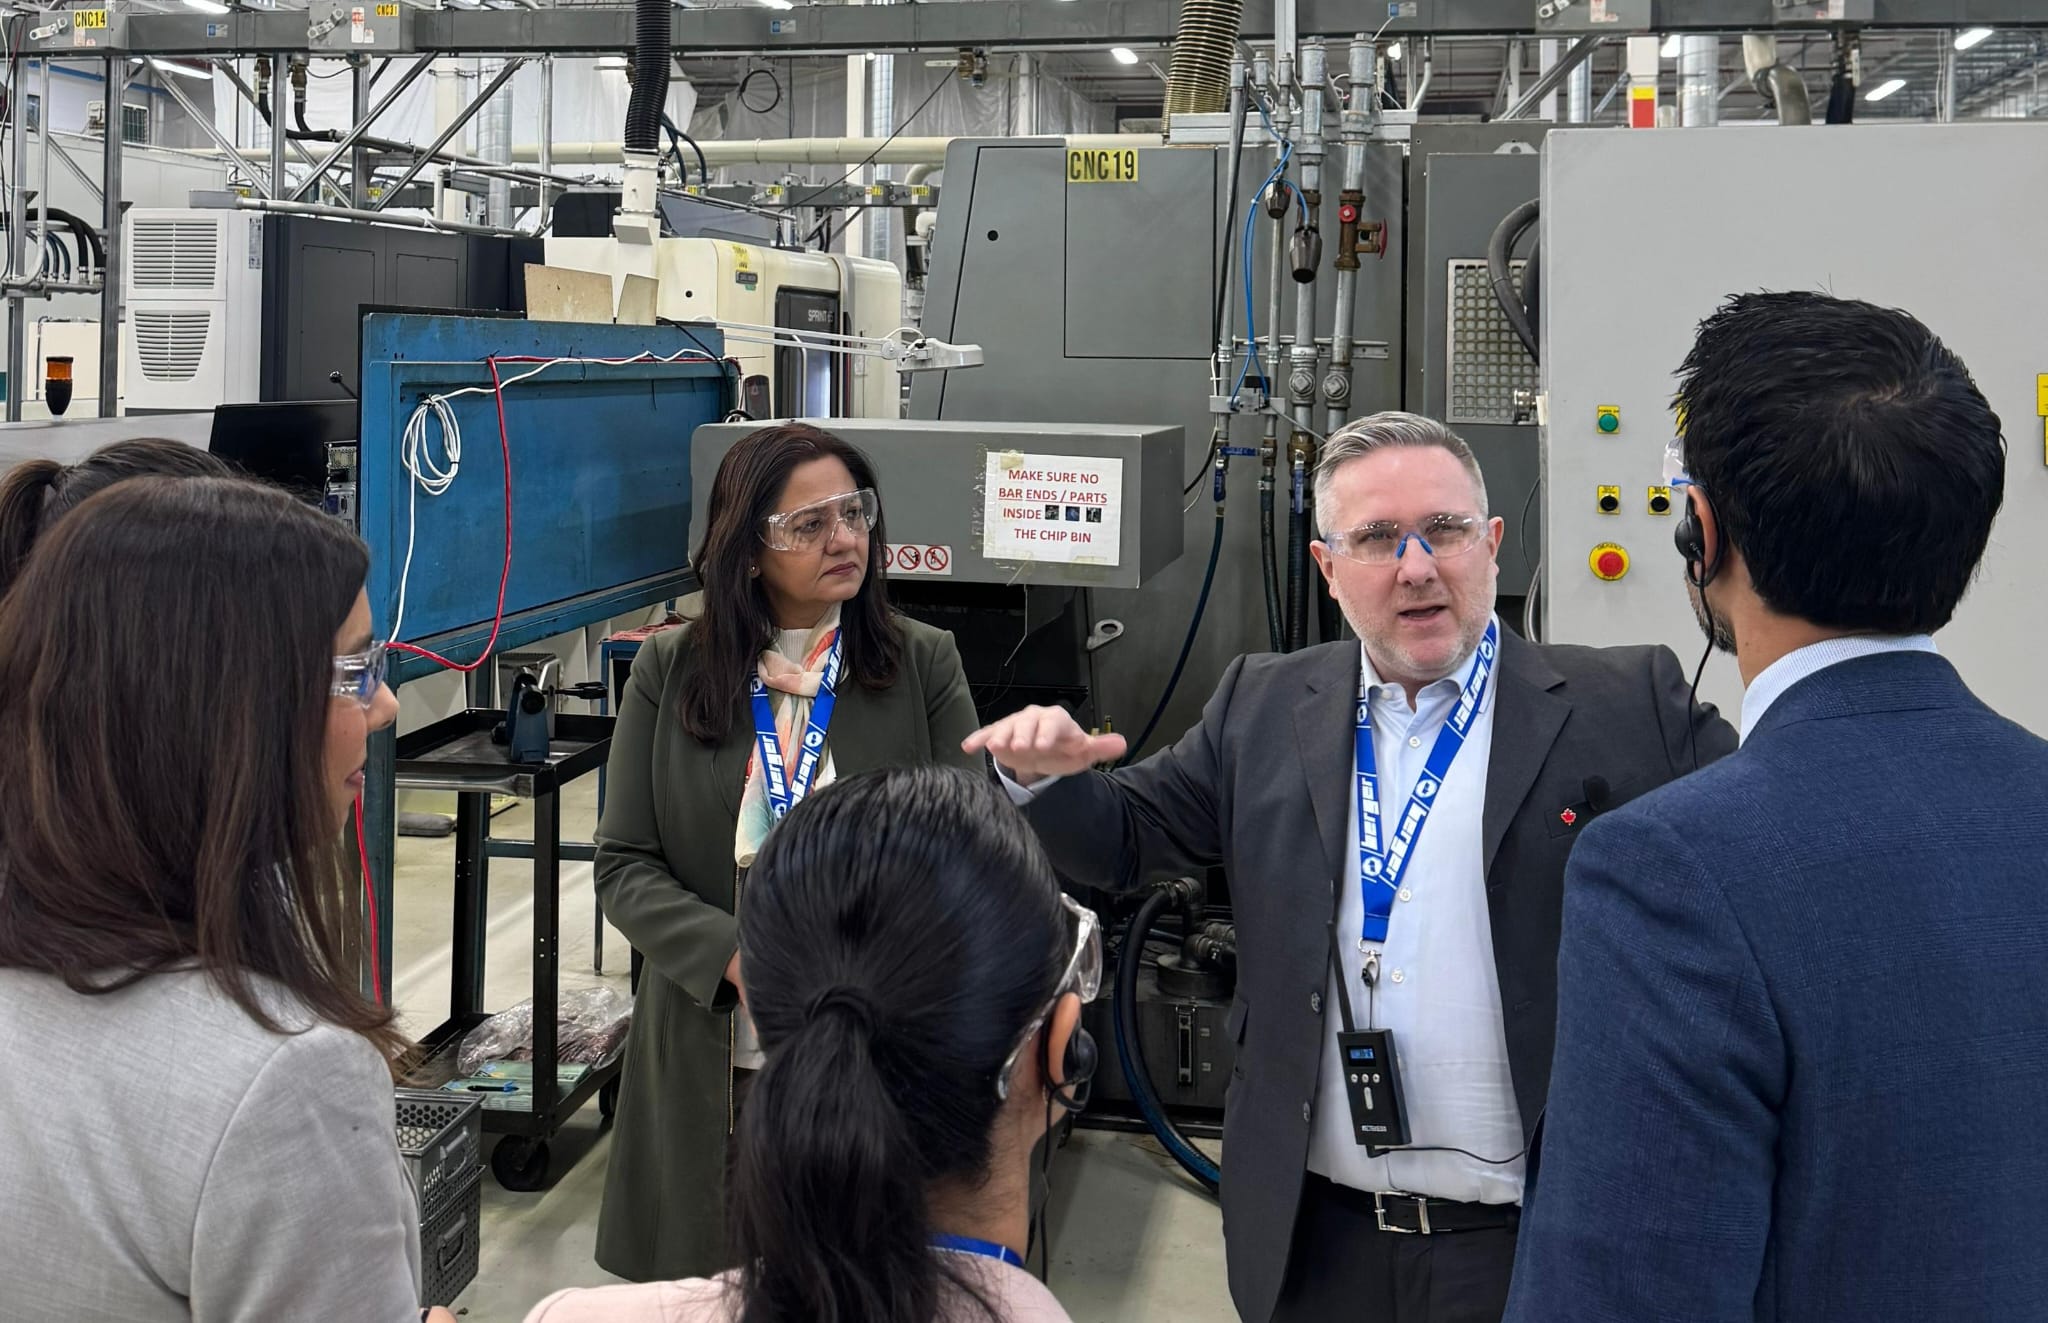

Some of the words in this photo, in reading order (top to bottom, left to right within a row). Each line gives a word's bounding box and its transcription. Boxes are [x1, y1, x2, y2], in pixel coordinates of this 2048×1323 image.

[75, 11, 106, 27] CNC14
[1070, 151, 1134, 180] CNC19
[808, 309, 827, 322] SPRINT
[1008, 469, 1043, 481] MAKE
[1046, 471, 1077, 483] SURE
[1080, 473, 1099, 485] NO
[998, 488, 1023, 499] BAR
[1026, 489, 1057, 501] ENDS
[1060, 489, 1067, 503] /
[1069, 491, 1107, 504] PARTS
[1003, 508, 1042, 520] INSIDE
[1014, 528, 1037, 540] THE
[1040, 530, 1067, 541] CHIP
[1070, 532, 1091, 543] BIN
[827, 631, 843, 690] erger
[1453, 660, 1488, 731] berger
[762, 735, 785, 797] berger
[1361, 777, 1379, 850] berger
[1386, 802, 1427, 881] berger
